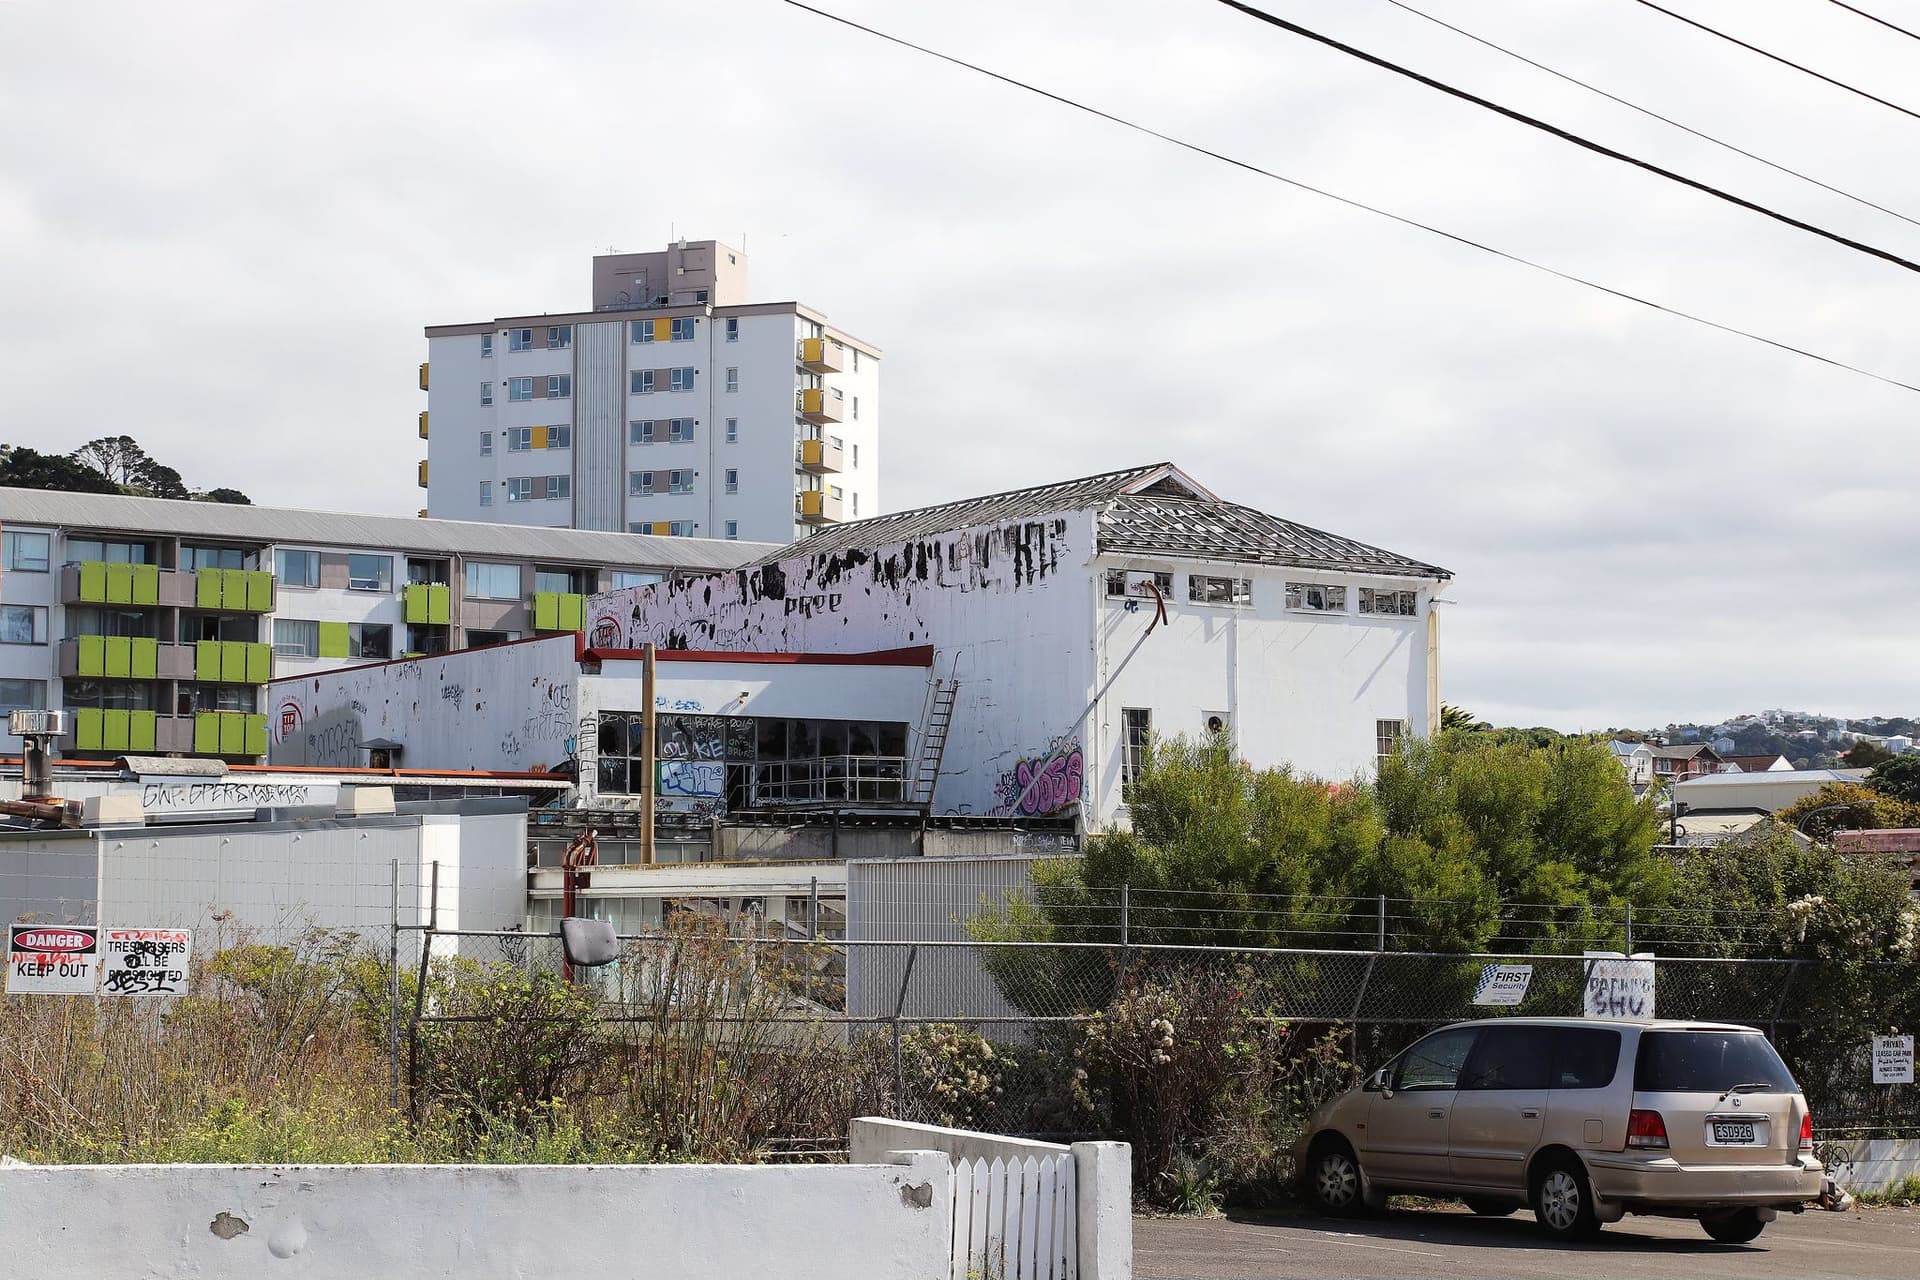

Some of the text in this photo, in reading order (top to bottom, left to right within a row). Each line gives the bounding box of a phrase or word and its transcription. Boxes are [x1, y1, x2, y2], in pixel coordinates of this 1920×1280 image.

[26, 934, 84, 948] DANGER
[154, 956, 169, 967] BE
[17, 962, 89, 978] KEEP OUT
[1495, 972, 1531, 982] FIRST
[1491, 982, 1527, 991] Security
[1716, 1125, 1752, 1138] ESD926
